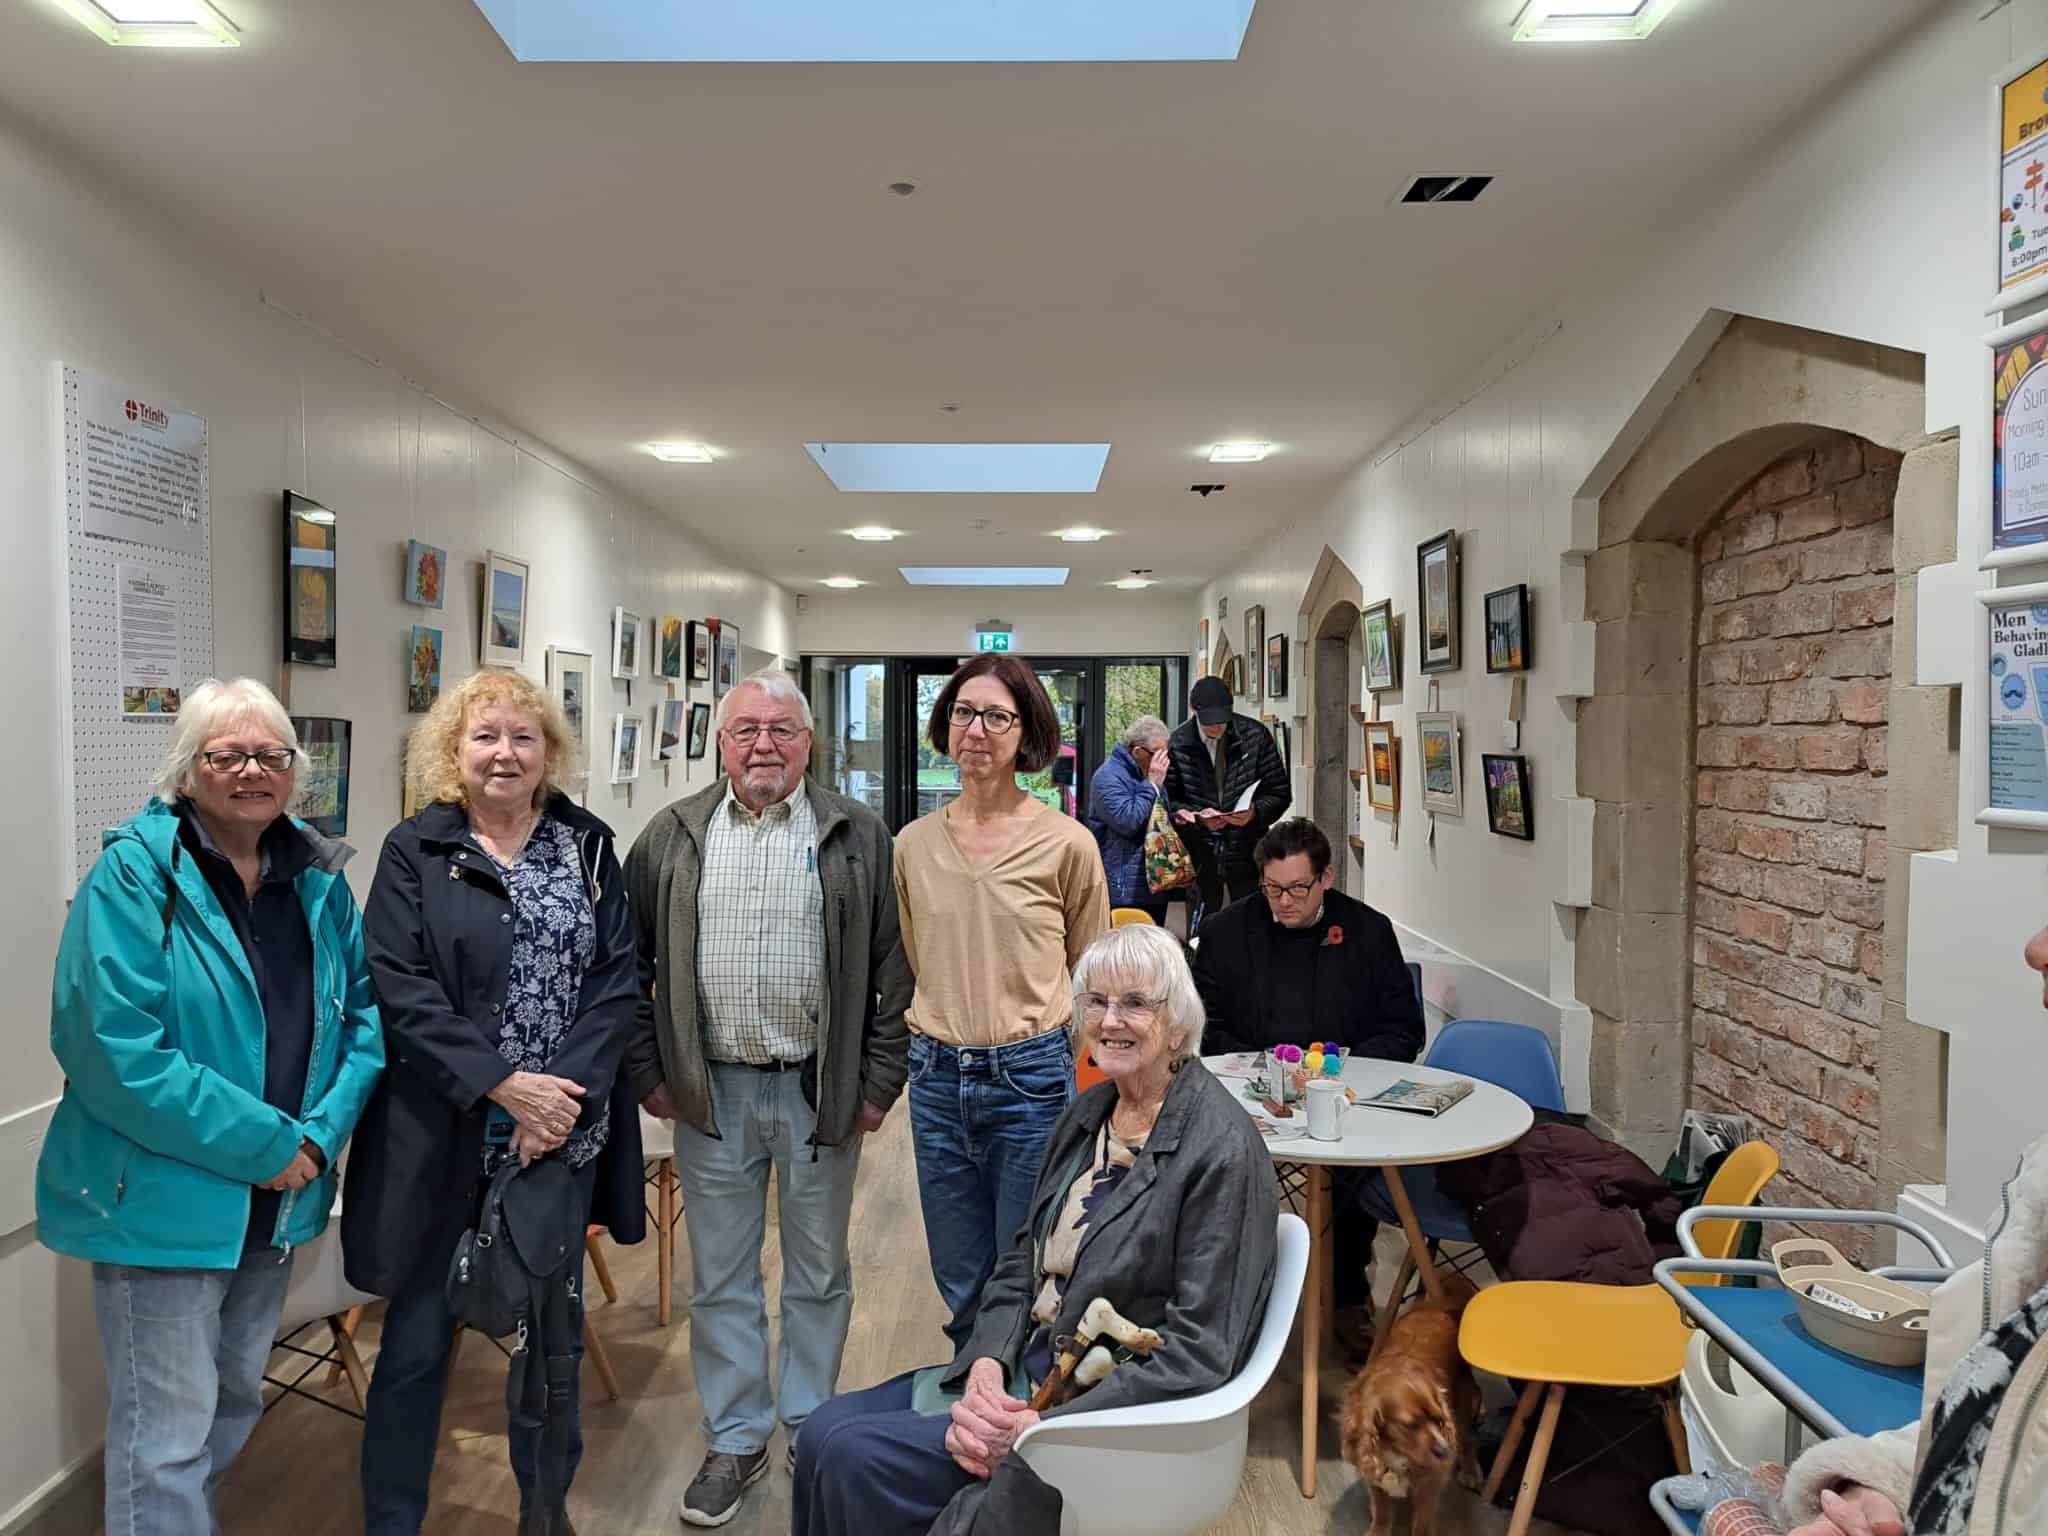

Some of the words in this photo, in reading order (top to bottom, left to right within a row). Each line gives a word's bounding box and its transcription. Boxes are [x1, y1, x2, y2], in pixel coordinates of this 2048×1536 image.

[139, 402, 169, 430] Trinity
[1994, 611, 2026, 628] Men
[1994, 628, 2048, 643] Behavin
[2013, 641, 2048, 657] Gladl
